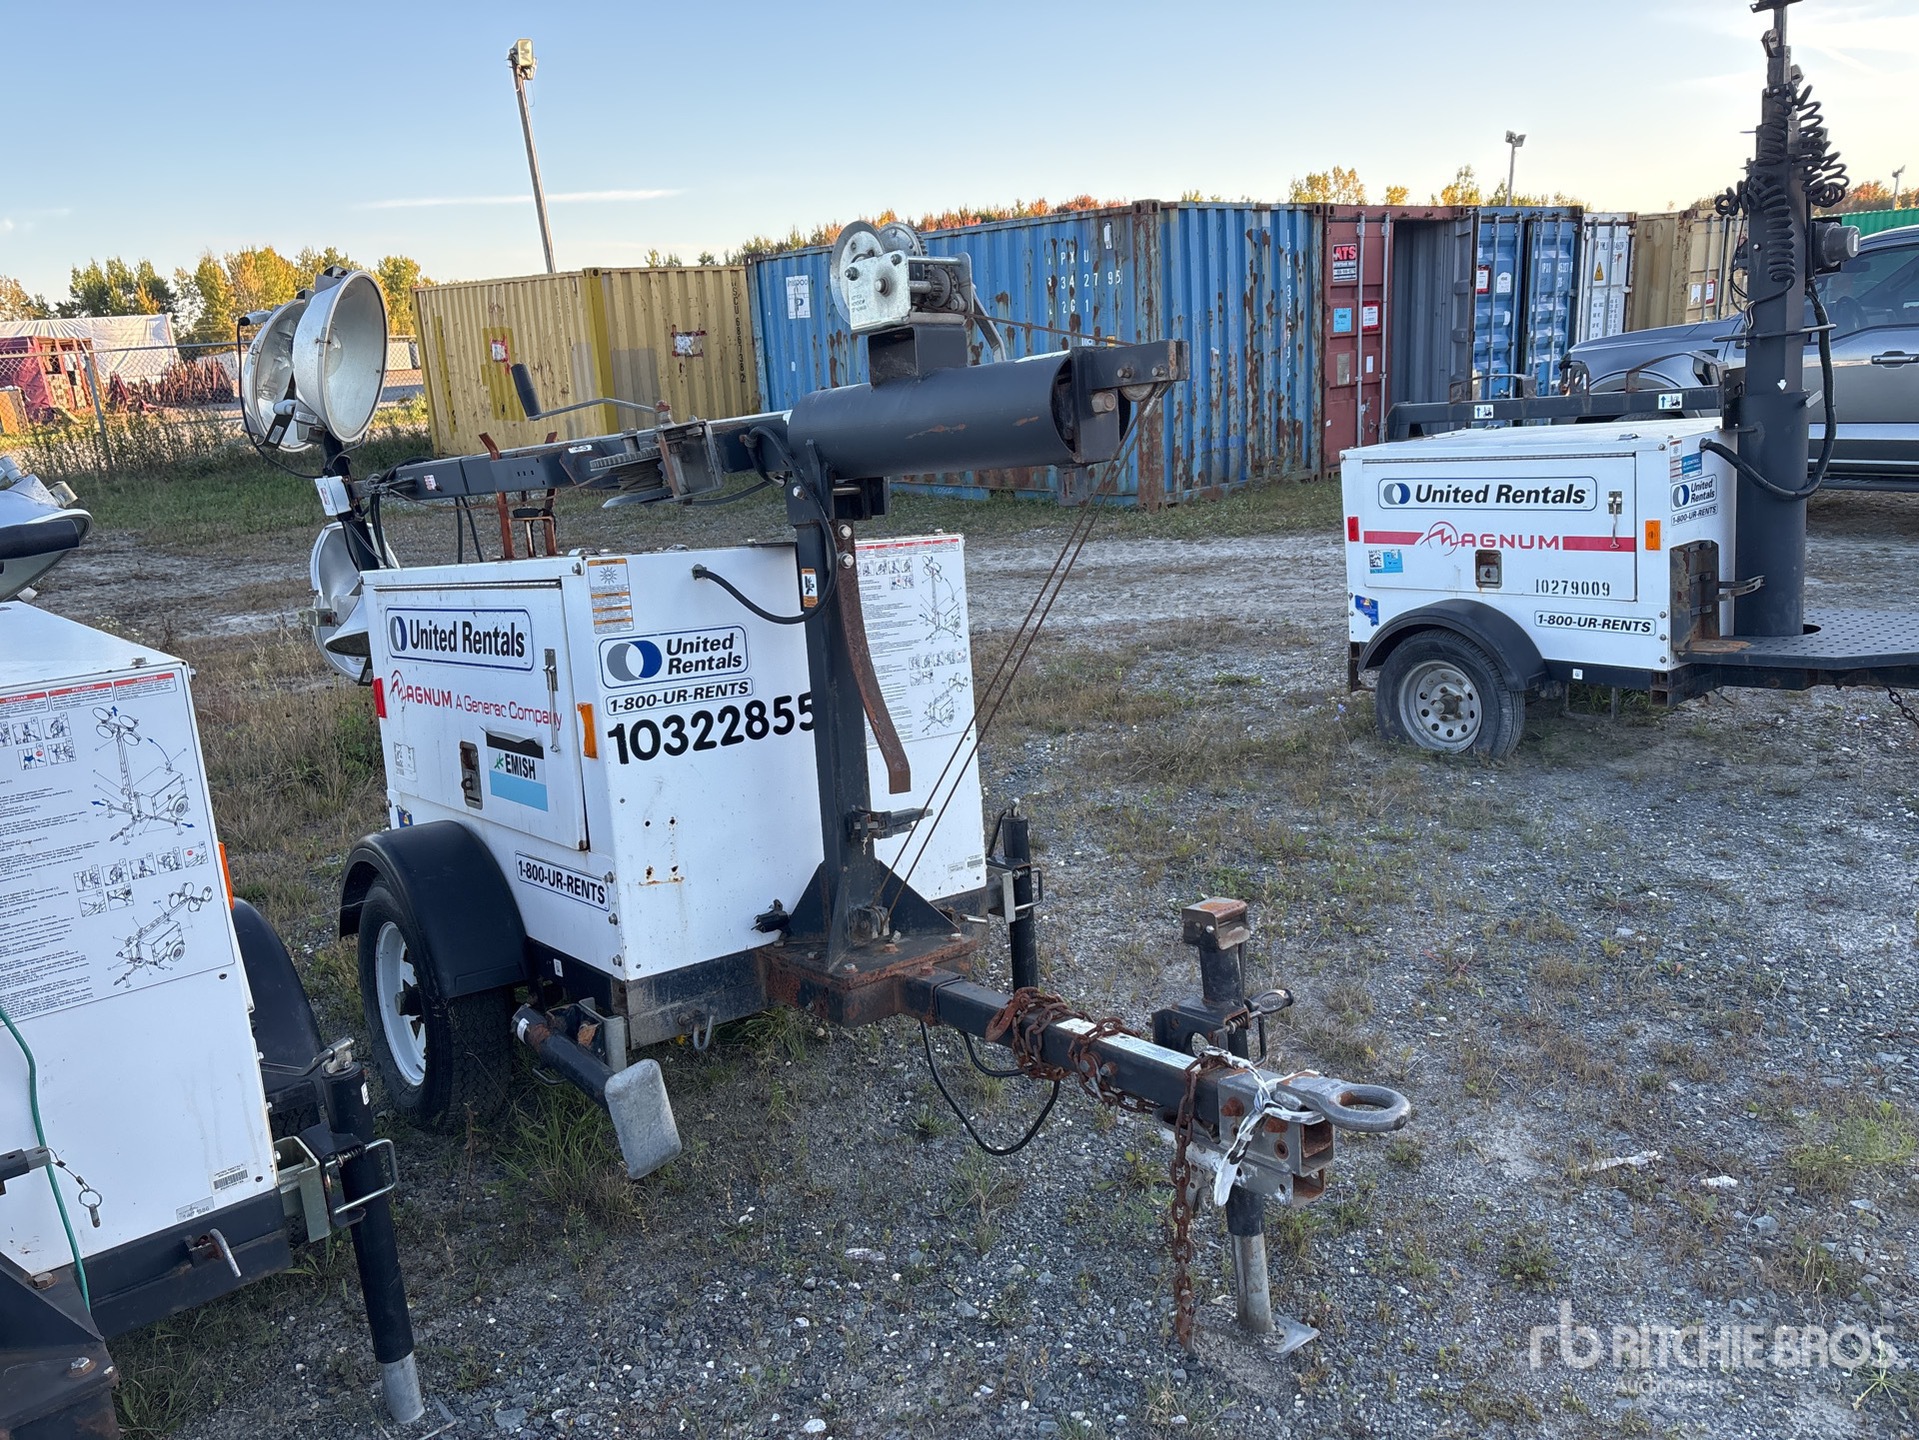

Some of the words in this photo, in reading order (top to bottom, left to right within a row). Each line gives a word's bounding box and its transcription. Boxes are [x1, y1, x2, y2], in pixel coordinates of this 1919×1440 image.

[1335, 246, 1356, 260] ATS
[1415, 484, 1490, 503] United
[1495, 484, 1586, 504] Rentals
[1690, 478, 1713, 492] United
[1690, 489, 1715, 503] Rentals
[1672, 505, 1717, 524] 1-800-UR-RENTS
[1419, 521, 1560, 556] MAGNUM
[1537, 613, 1651, 633] 1-800-UR-RENTS
[409, 618, 457, 652] United
[461, 620, 525, 658] Rentals
[666, 632, 735, 656] United
[667, 652, 743, 675] Rentals
[455, 694, 463, 710] A
[464, 695, 507, 718] Generac
[610, 681, 749, 712] 1-800-UR-RENTS
[607, 691, 815, 765] 10322855
[505, 753, 536, 780] EMISH
[518, 860, 605, 905] 1-800-UR-RENTS
